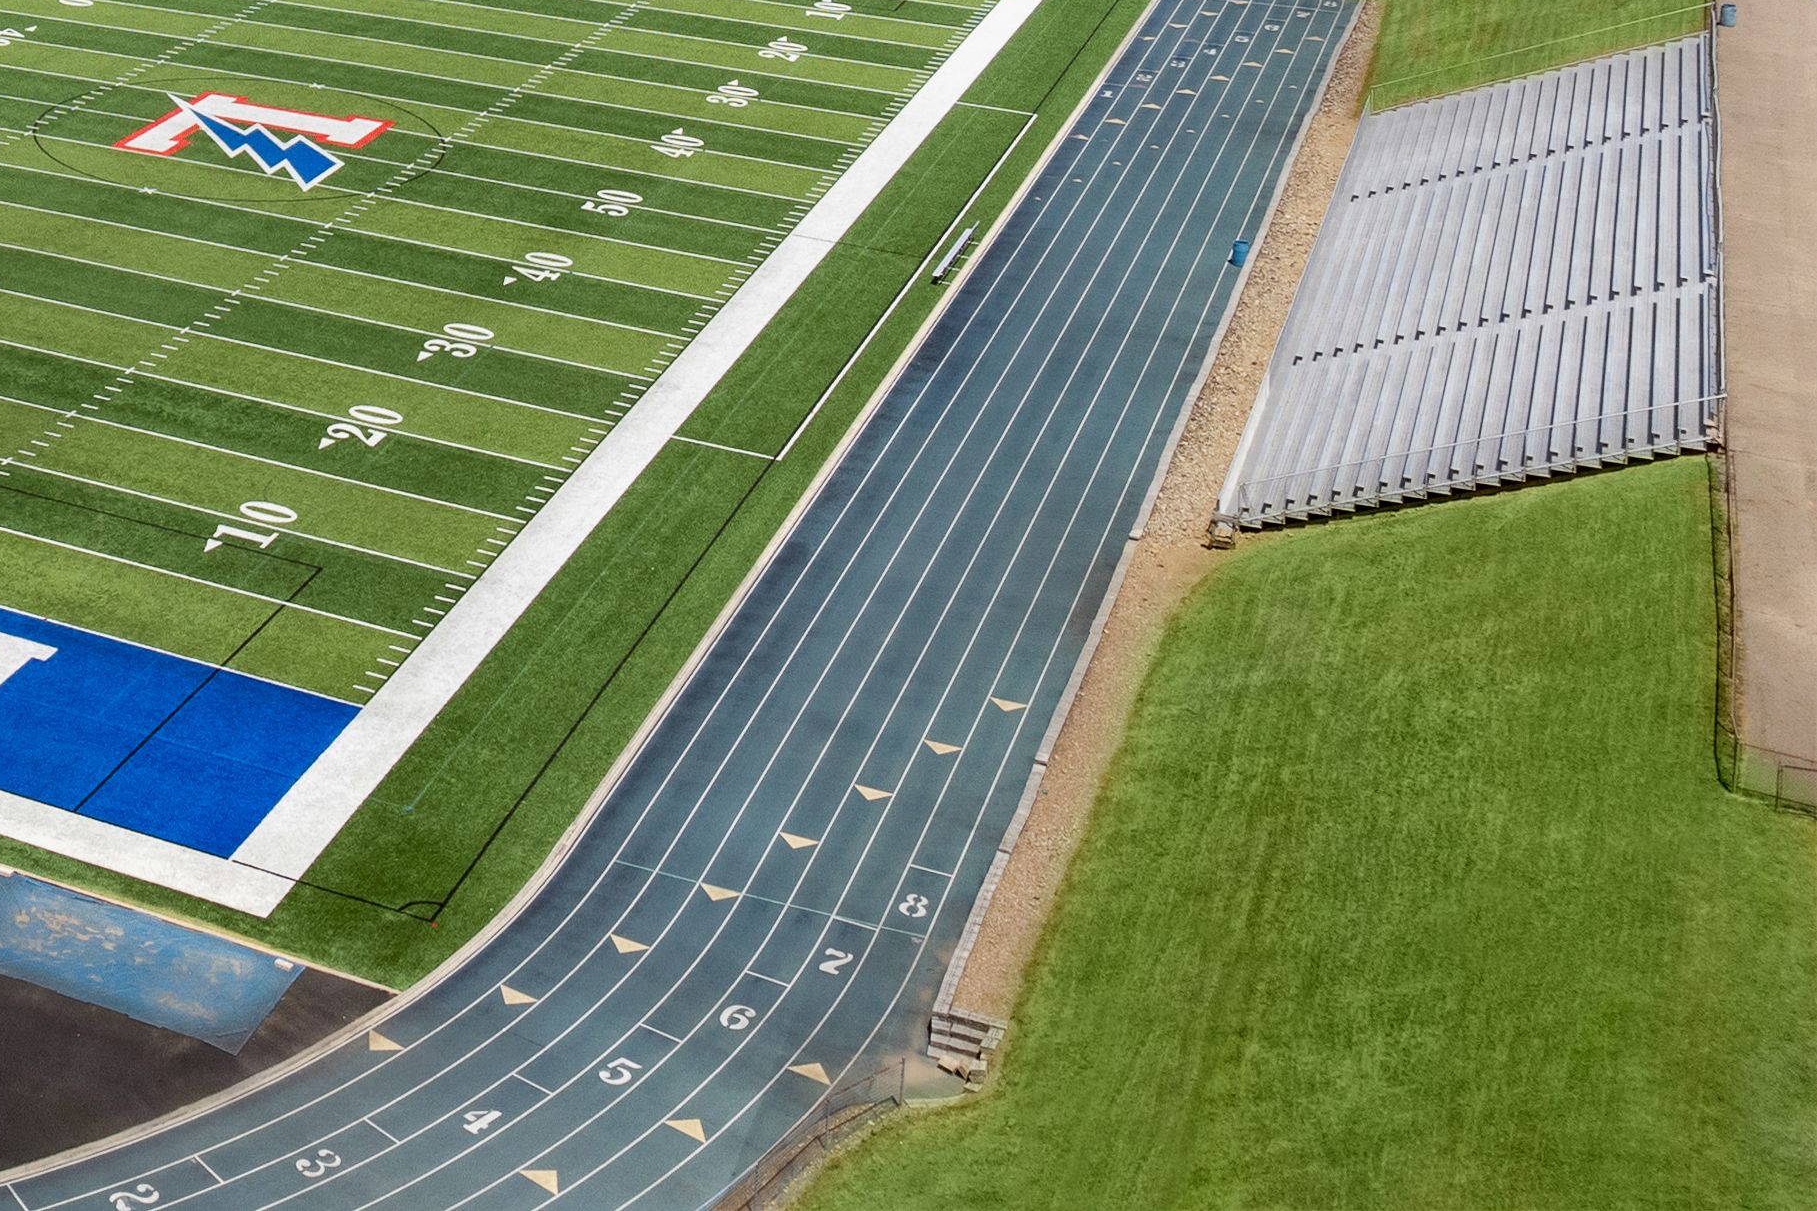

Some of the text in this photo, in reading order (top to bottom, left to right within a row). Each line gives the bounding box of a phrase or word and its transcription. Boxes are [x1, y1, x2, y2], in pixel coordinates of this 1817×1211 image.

[805, 0, 852, 21] 10
[758, 40, 808, 62] 20
[706, 84, 759, 108] 30
[650, 133, 704, 159] 40
[581, 189, 643, 217] 50
[511, 251, 573, 283] 40
[423, 322, 495, 358] 30
[326, 404, 403, 448] 20
[213, 500, 298, 549] 10
[109, 893, 930, 1211] 2 3 4 5 6 7 8
